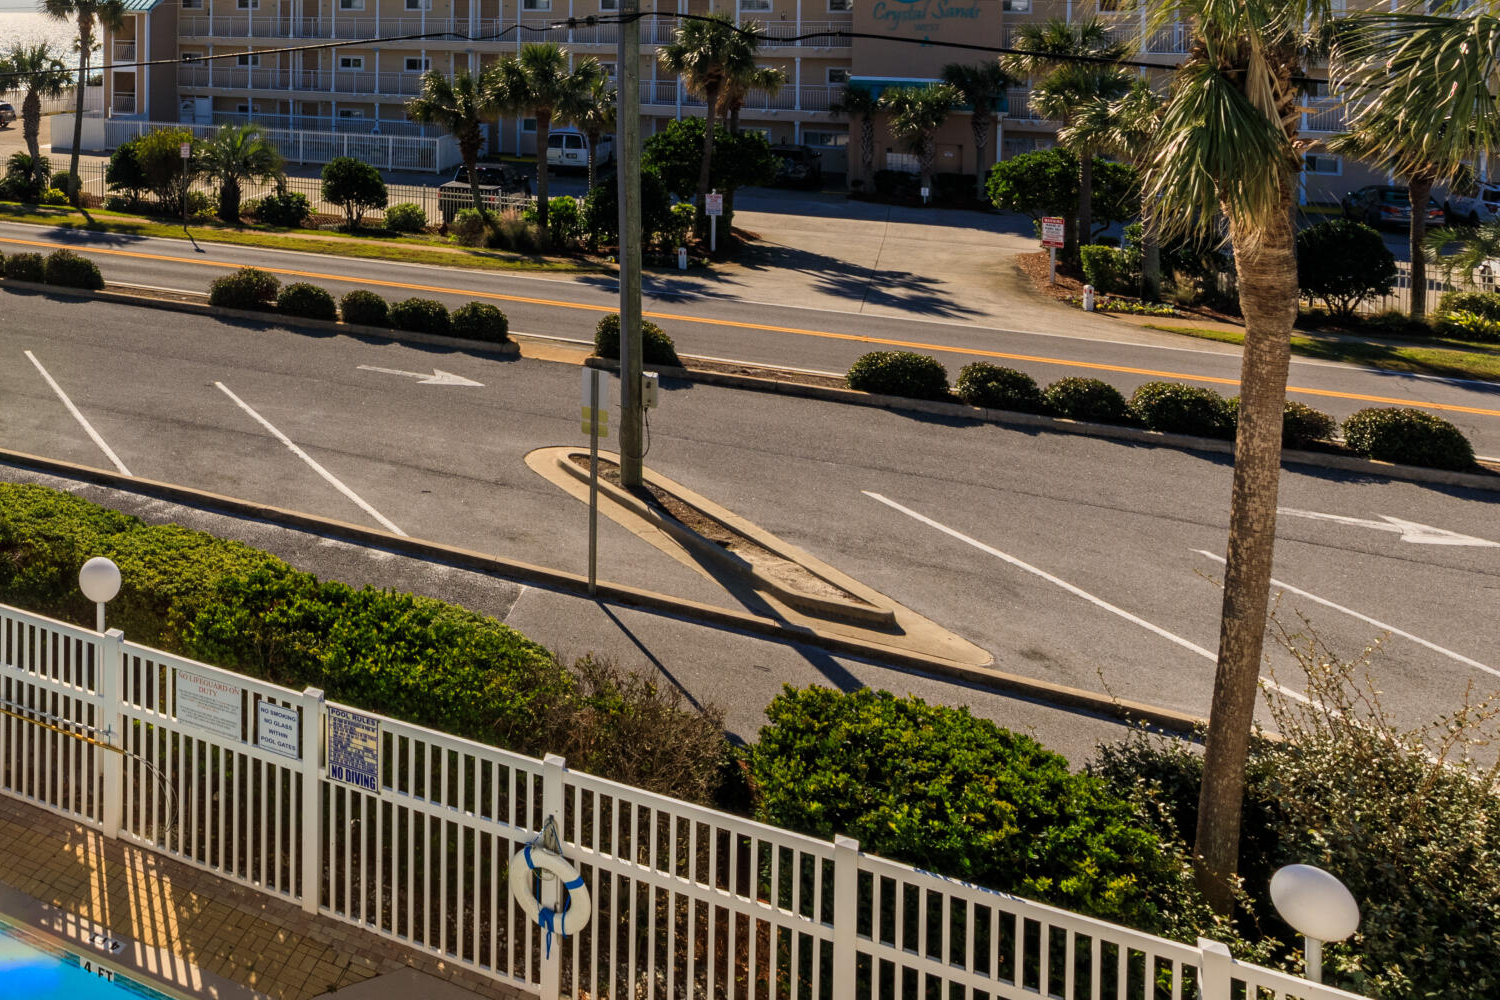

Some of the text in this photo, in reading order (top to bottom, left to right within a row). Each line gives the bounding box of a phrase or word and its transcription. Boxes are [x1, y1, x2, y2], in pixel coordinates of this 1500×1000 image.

[873, 0, 980, 31] Crystal Sands
[915, 23, 939, 31] WEST
[178, 671, 240, 695] NO LIFEGUARD ON
[198, 686, 217, 697] DUTY
[260, 706, 296, 722] NO SMOKING
[331, 709, 376, 726] POOL RULES
[268, 728, 288, 739] WITHIN
[273, 720, 292, 731] GLASS
[260, 736, 296, 751] POOL GATES
[331, 764, 376, 791] NO DIVING
[84, 961, 112, 982] 4 FT
